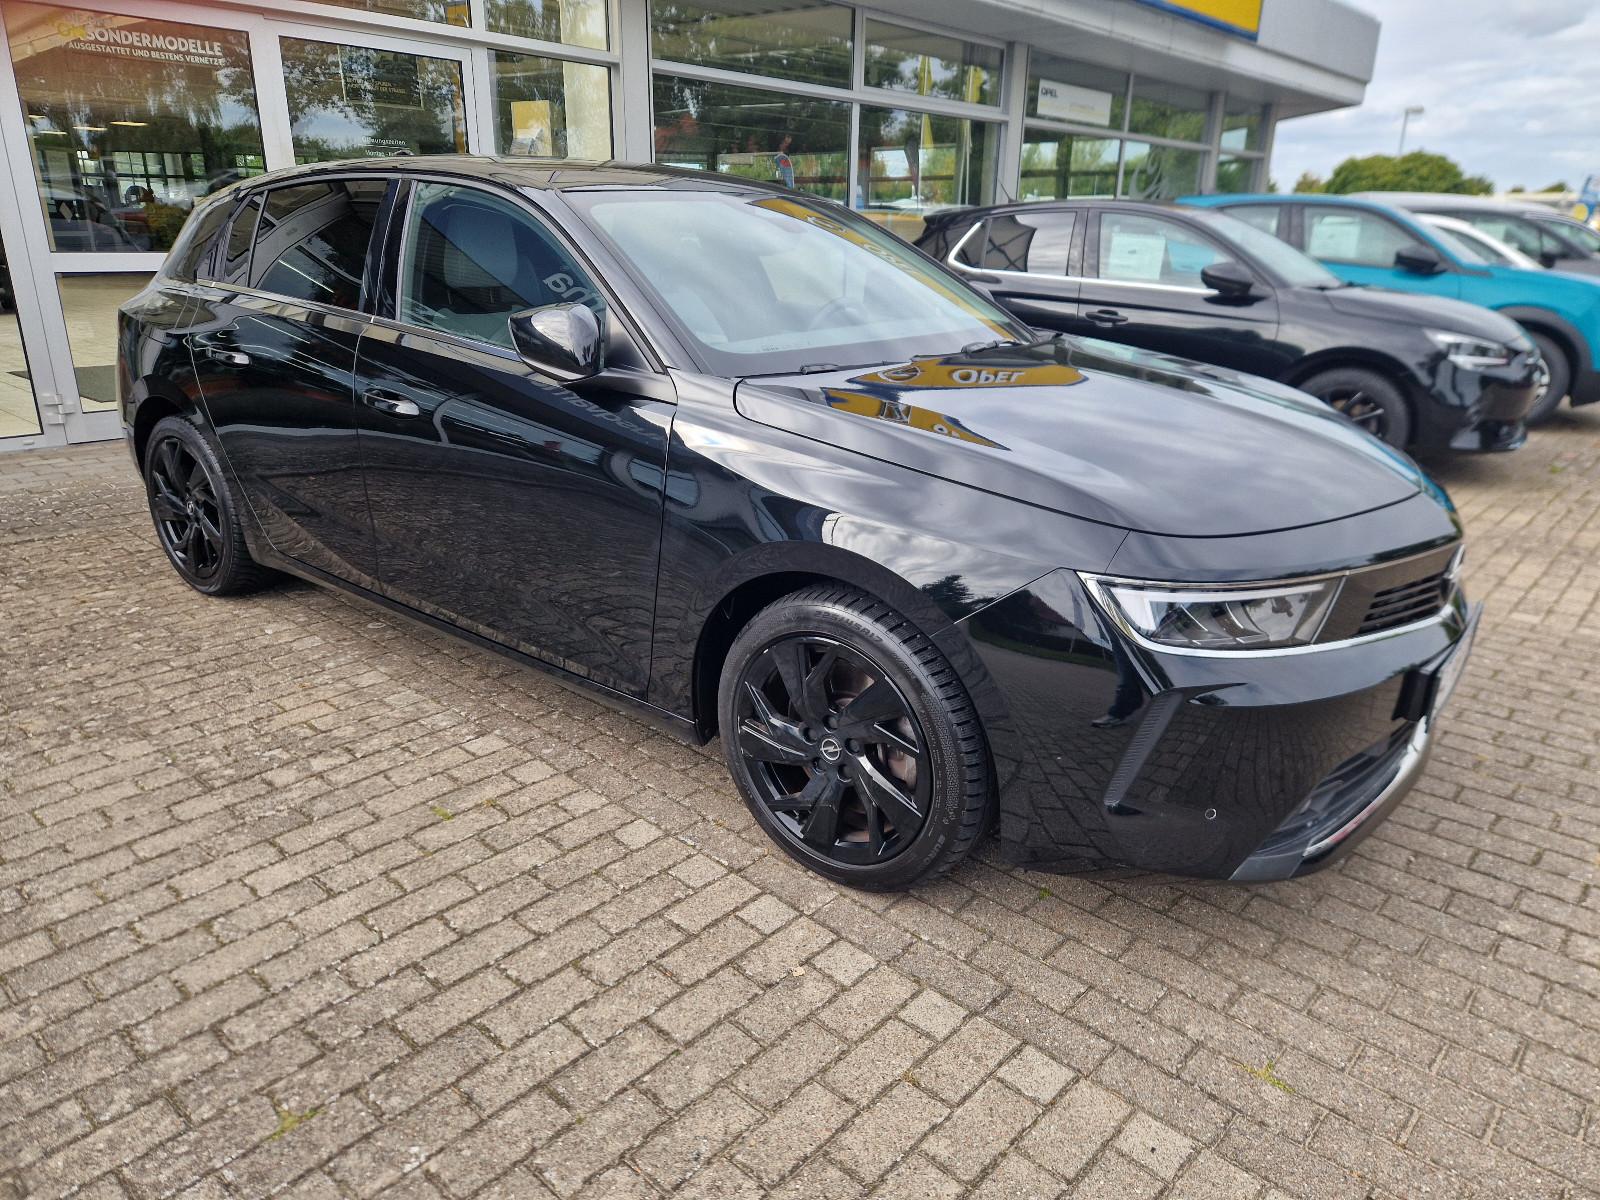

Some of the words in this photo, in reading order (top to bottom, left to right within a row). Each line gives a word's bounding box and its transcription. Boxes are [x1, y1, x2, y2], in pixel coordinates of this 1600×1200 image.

[68, 41, 131, 56] AUSGESTATTET
[132, 48, 150, 58] UND
[151, 51, 184, 62] BESTENS
[86, 26, 223, 56] SONDERMODELLE
[1041, 87, 1058, 97] OPEL
